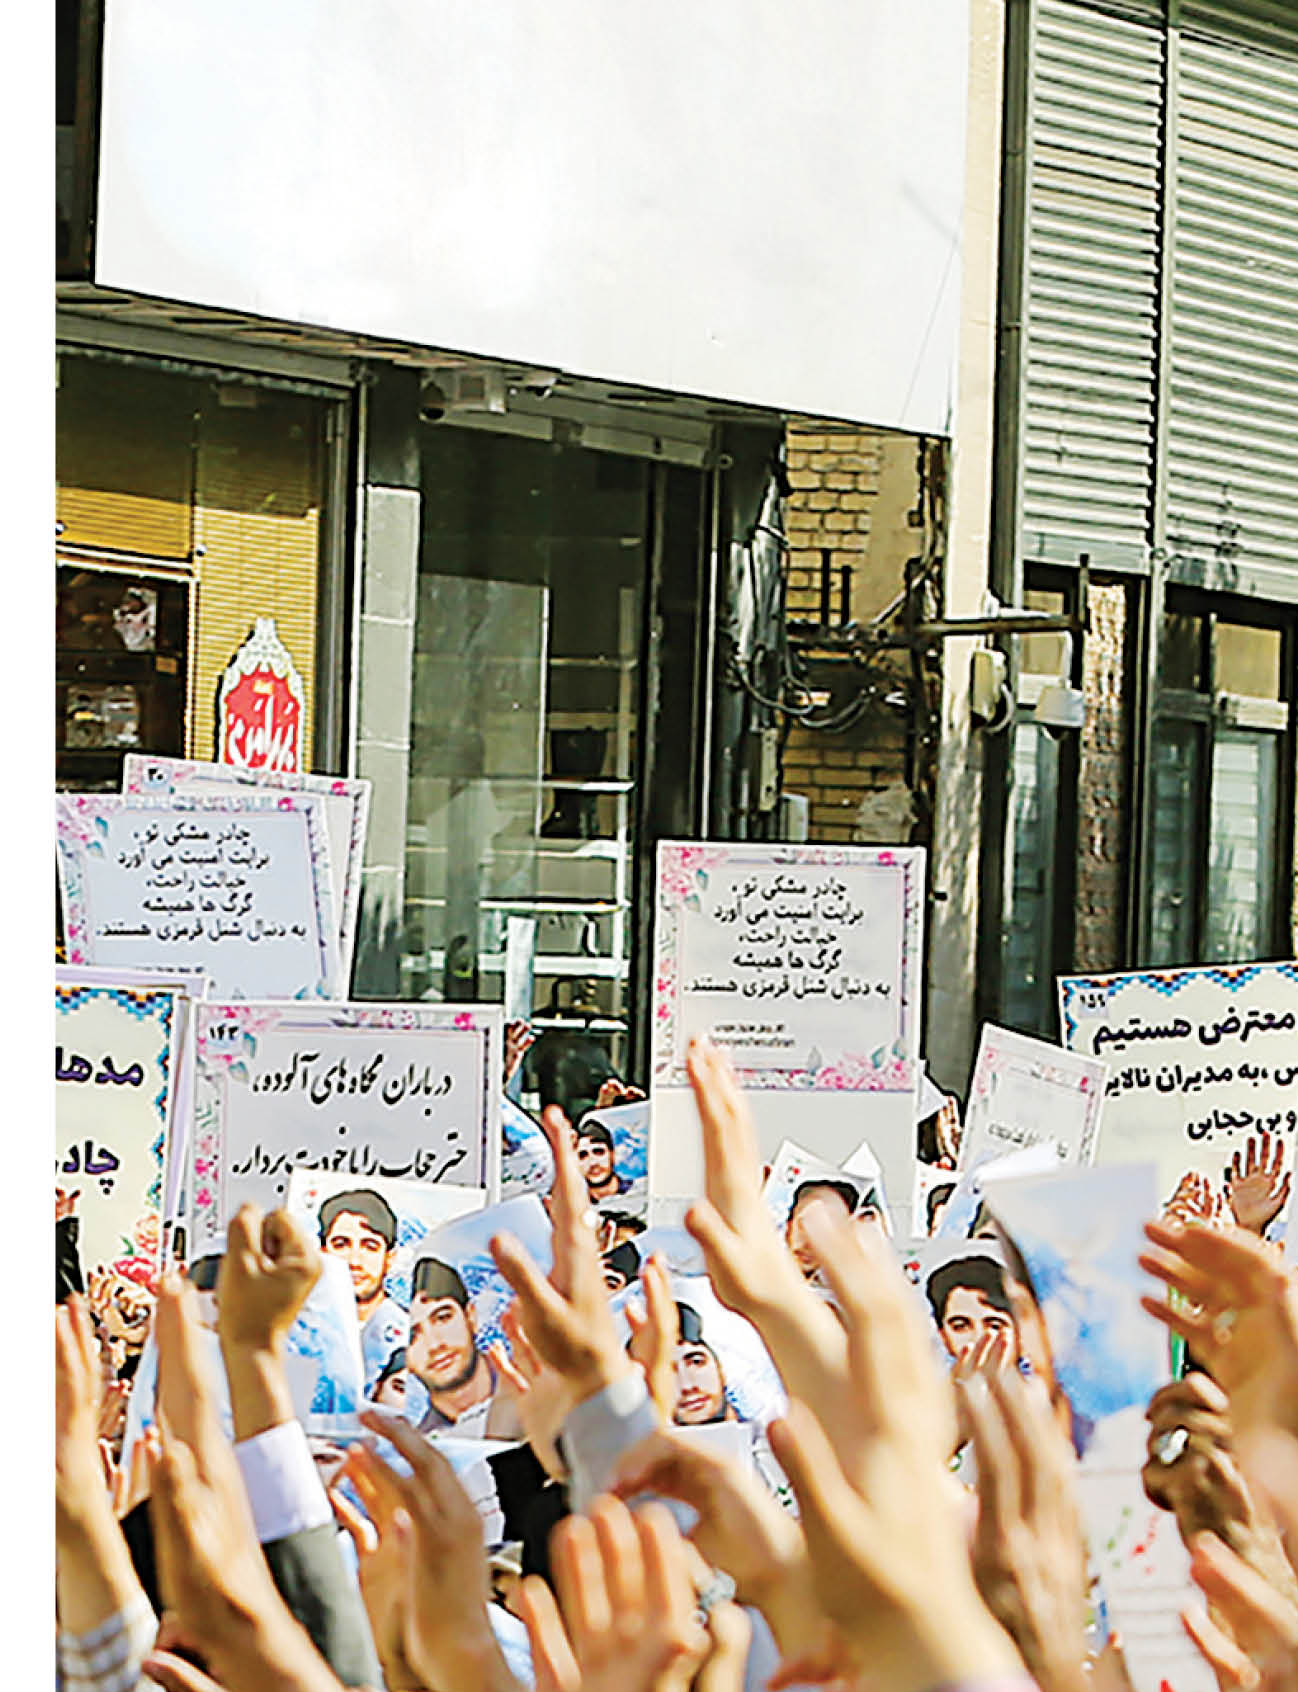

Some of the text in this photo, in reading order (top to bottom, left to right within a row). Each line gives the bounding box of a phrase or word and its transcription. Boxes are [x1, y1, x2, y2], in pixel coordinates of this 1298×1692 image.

[164, 822, 209, 847] مشکی
[152, 855, 173, 870] می
[229, 848, 269, 869] برایت
[761, 875, 806, 901] مشکی
[143, 893, 252, 916] گرگ ها همیشه
[746, 909, 768, 925] می
[822, 900, 863, 925] برایت
[290, 924, 306, 939] به
[733, 949, 842, 974] گرگ ها همیشه
[875, 982, 891, 999] به
[1093, 1018, 1191, 1055] هستیم
[1199, 1007, 1295, 1045] معترض
[1156, 1065, 1232, 1092] مدیران
[1286, 1111, 1296, 1132] و
[56, 1141, 119, 1194] چاد
